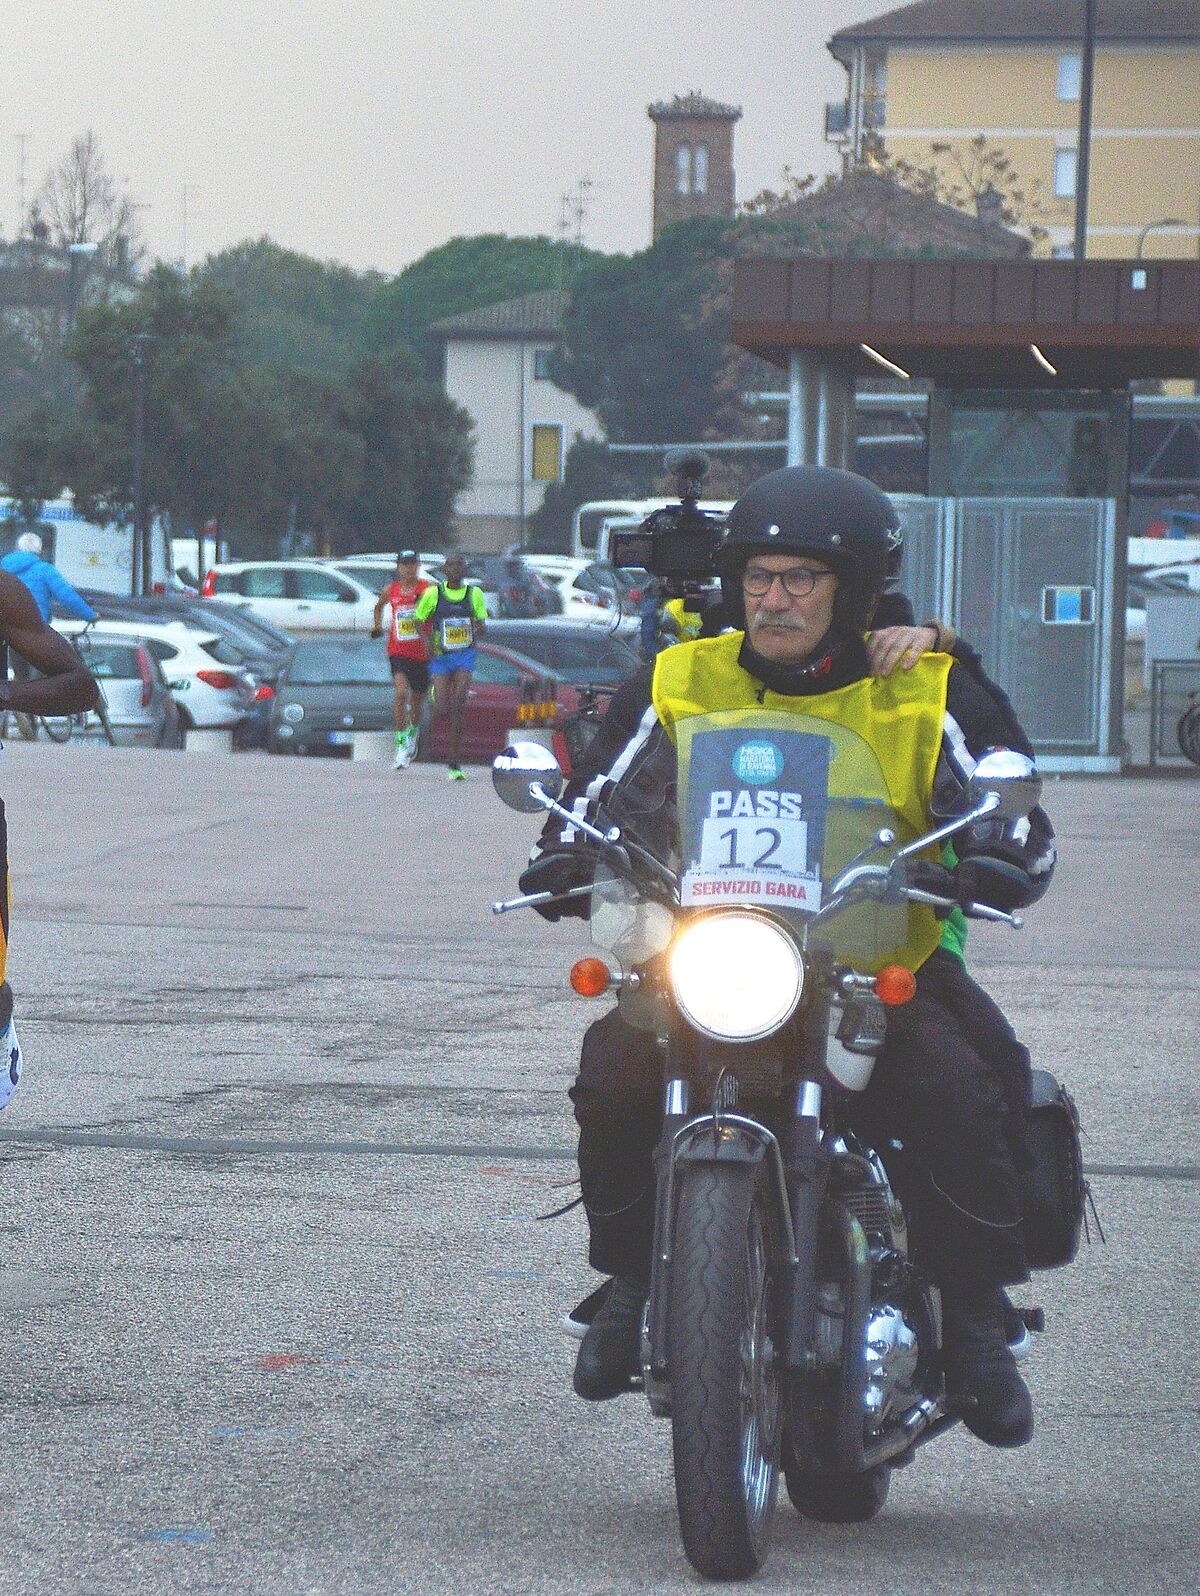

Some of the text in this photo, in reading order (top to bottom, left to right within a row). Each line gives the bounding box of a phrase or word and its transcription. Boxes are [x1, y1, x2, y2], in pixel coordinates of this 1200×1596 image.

[710, 790, 802, 819] PASS
[719, 827, 782, 869] 12
[692, 880, 807, 900] SERVIZIO GARA
